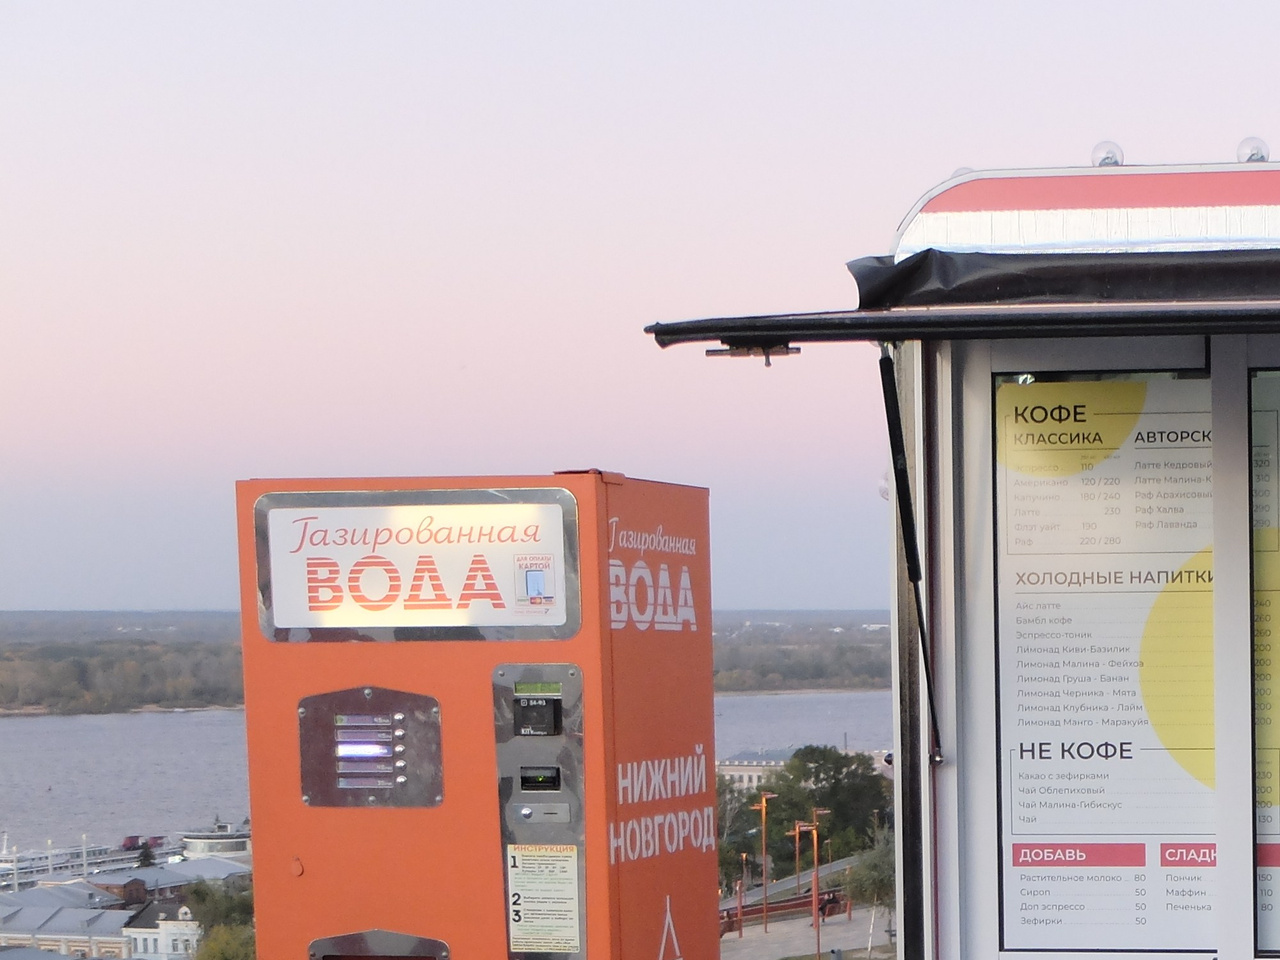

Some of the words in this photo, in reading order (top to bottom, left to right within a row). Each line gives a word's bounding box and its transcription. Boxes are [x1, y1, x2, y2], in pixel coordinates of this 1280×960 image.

[1014, 405, 1087, 423] КОФЕ
[1014, 432, 1102, 444] КЛАССИКА
[1134, 430, 1212, 443] АВТОРСК
[1081, 463, 1093, 471] 110
[1134, 462, 1161, 470] Латте
[1164, 460, 1212, 470] Кедровый
[1014, 494, 1060, 503] Капучино
[1081, 492, 1095, 500] 180
[1104, 492, 1120, 500] 240
[1104, 507, 1120, 515] 230
[1135, 506, 1154, 514] Раф
[1015, 523, 1036, 531] Флэт
[1039, 523, 1060, 532] уайт
[1082, 522, 1097, 530] 190
[1135, 521, 1154, 529] Раф
[1156, 520, 1197, 529] Лаванда
[289, 516, 541, 555] Газированная
[609, 517, 696, 556] Газированная
[1015, 538, 1033, 546] Раф
[1080, 537, 1095, 545] 220
[519, 562, 550, 570] КАРТОЙ
[306, 554, 506, 612] ВОДА
[1016, 572, 1124, 587] ХОЛОДНЫЕ
[609, 559, 697, 631] ВОДА
[1016, 602, 1033, 610] Айс
[1016, 616, 1046, 624] Бамбл
[1049, 616, 1072, 625] кофе
[1016, 631, 1092, 640] Эспрессо-тоник
[1016, 646, 1059, 654] Лимонад
[1062, 645, 1130, 653] Киви-Базилик
[1016, 660, 1060, 668] Лимонад
[1108, 659, 1144, 667] Фейхоа
[1017, 675, 1060, 683] Лимонад
[1063, 675, 1091, 684] Груша
[1017, 689, 1061, 697] Лимонад
[1063, 689, 1104, 698] Черника
[1112, 689, 1136, 697] Мята
[1017, 704, 1061, 712] Лимонад
[1063, 703, 1108, 713] Клубника
[1117, 703, 1143, 711] Лайм
[1017, 719, 1061, 727] Лимонад
[1063, 718, 1093, 726] Манго
[1101, 718, 1149, 727] Маракуйя
[1019, 742, 1052, 760] НЕ
[1061, 742, 1133, 760] КОФЕ
[618, 744, 706, 805] НИЖНИЙ
[1055, 772, 1109, 781] зефирками
[1039, 786, 1105, 794] Облепиховый
[1039, 801, 1122, 810] Малина-Гибискус
[1258, 815, 1273, 823] 130
[609, 806, 716, 865] НОВГОРОД
[513, 845, 575, 853] ИНСТРУКЦИЯ
[1019, 849, 1086, 862] ДОБАВЬ
[511, 856, 518, 868] 1
[1020, 874, 1084, 882] Растительное
[1134, 874, 1146, 882] 80
[1165, 874, 1202, 882] Пончик
[1020, 889, 1051, 897] Сироп
[1166, 889, 1206, 897] Маффин
[1261, 889, 1273, 897] 110
[512, 893, 521, 906] 2
[1020, 903, 1039, 911] Доп
[1135, 903, 1147, 911] 50
[1166, 903, 1212, 911] Печенька
[512, 910, 522, 923] 3
[1021, 917, 1063, 925] Зефирки
